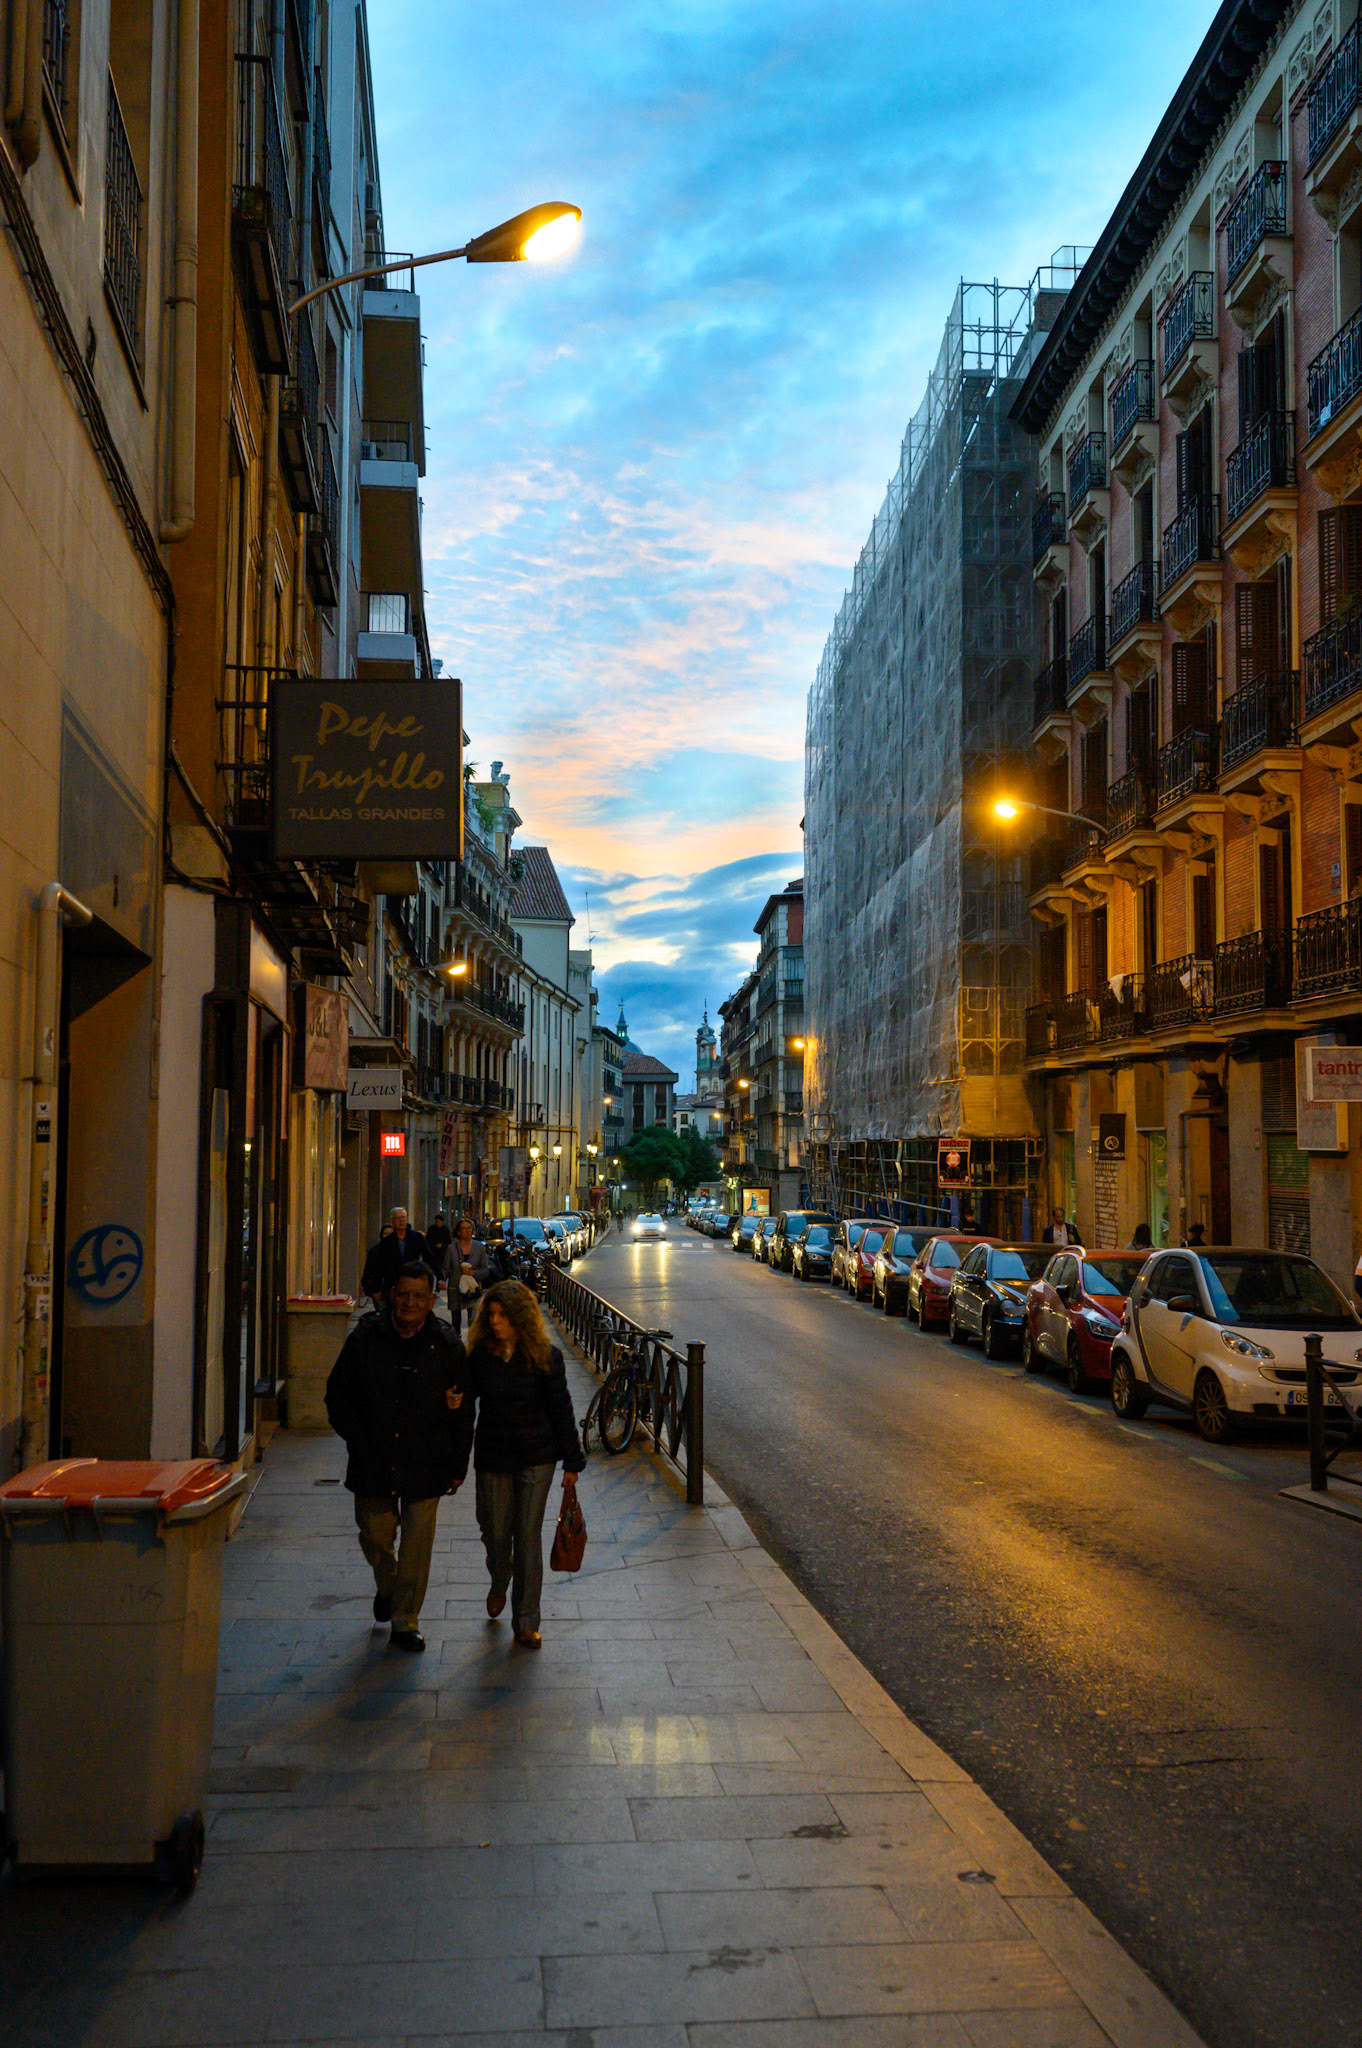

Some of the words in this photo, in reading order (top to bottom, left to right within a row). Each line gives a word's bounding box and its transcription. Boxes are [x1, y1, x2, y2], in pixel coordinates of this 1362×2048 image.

[317, 701, 424, 751] Pepe
[291, 752, 445, 804] Trujillo
[289, 807, 352, 820] TALLAS
[358, 807, 445, 820] GRANDES
[351, 1081, 397, 1096] Lexus
